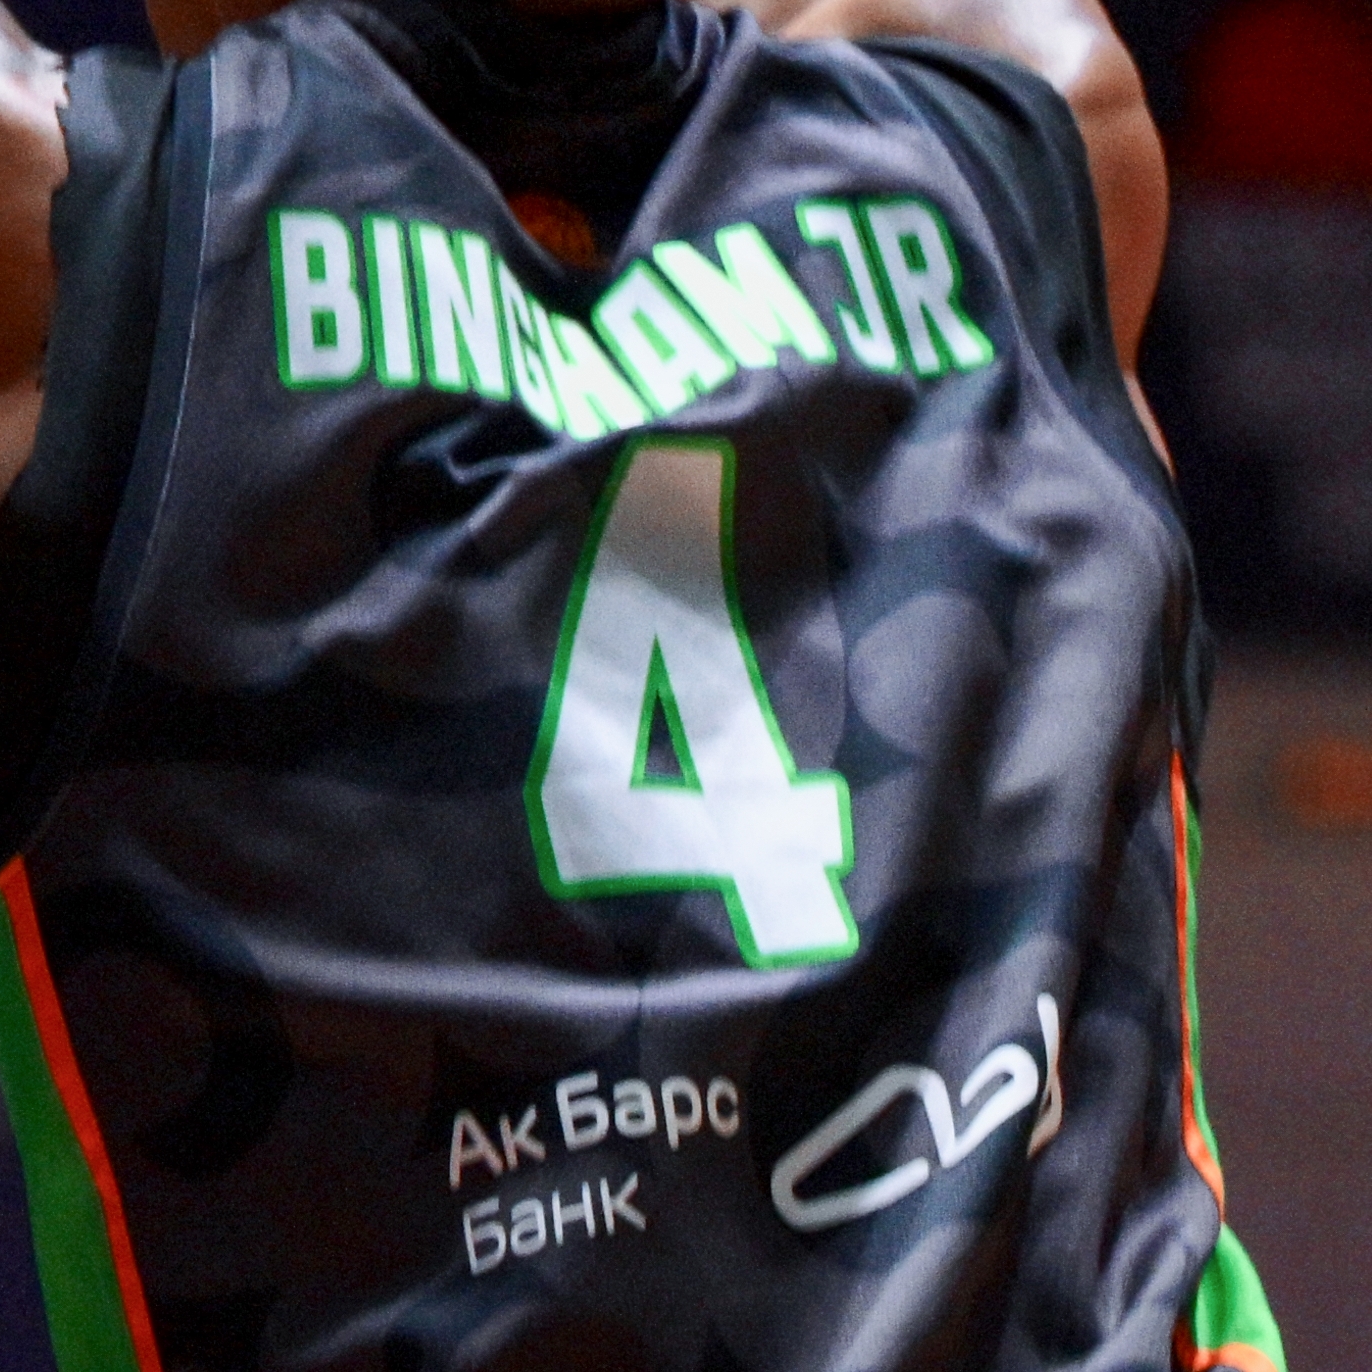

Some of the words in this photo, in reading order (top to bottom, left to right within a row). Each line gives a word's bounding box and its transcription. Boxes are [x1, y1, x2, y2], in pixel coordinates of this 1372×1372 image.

[268, 206, 838, 442] BINGHAM
[796, 194, 995, 379] JR
[523, 436, 860, 969] 4
[449, 1103, 547, 1190] Ак
[555, 1069, 741, 1152] Барс
[462, 1170, 647, 1276] Банк
